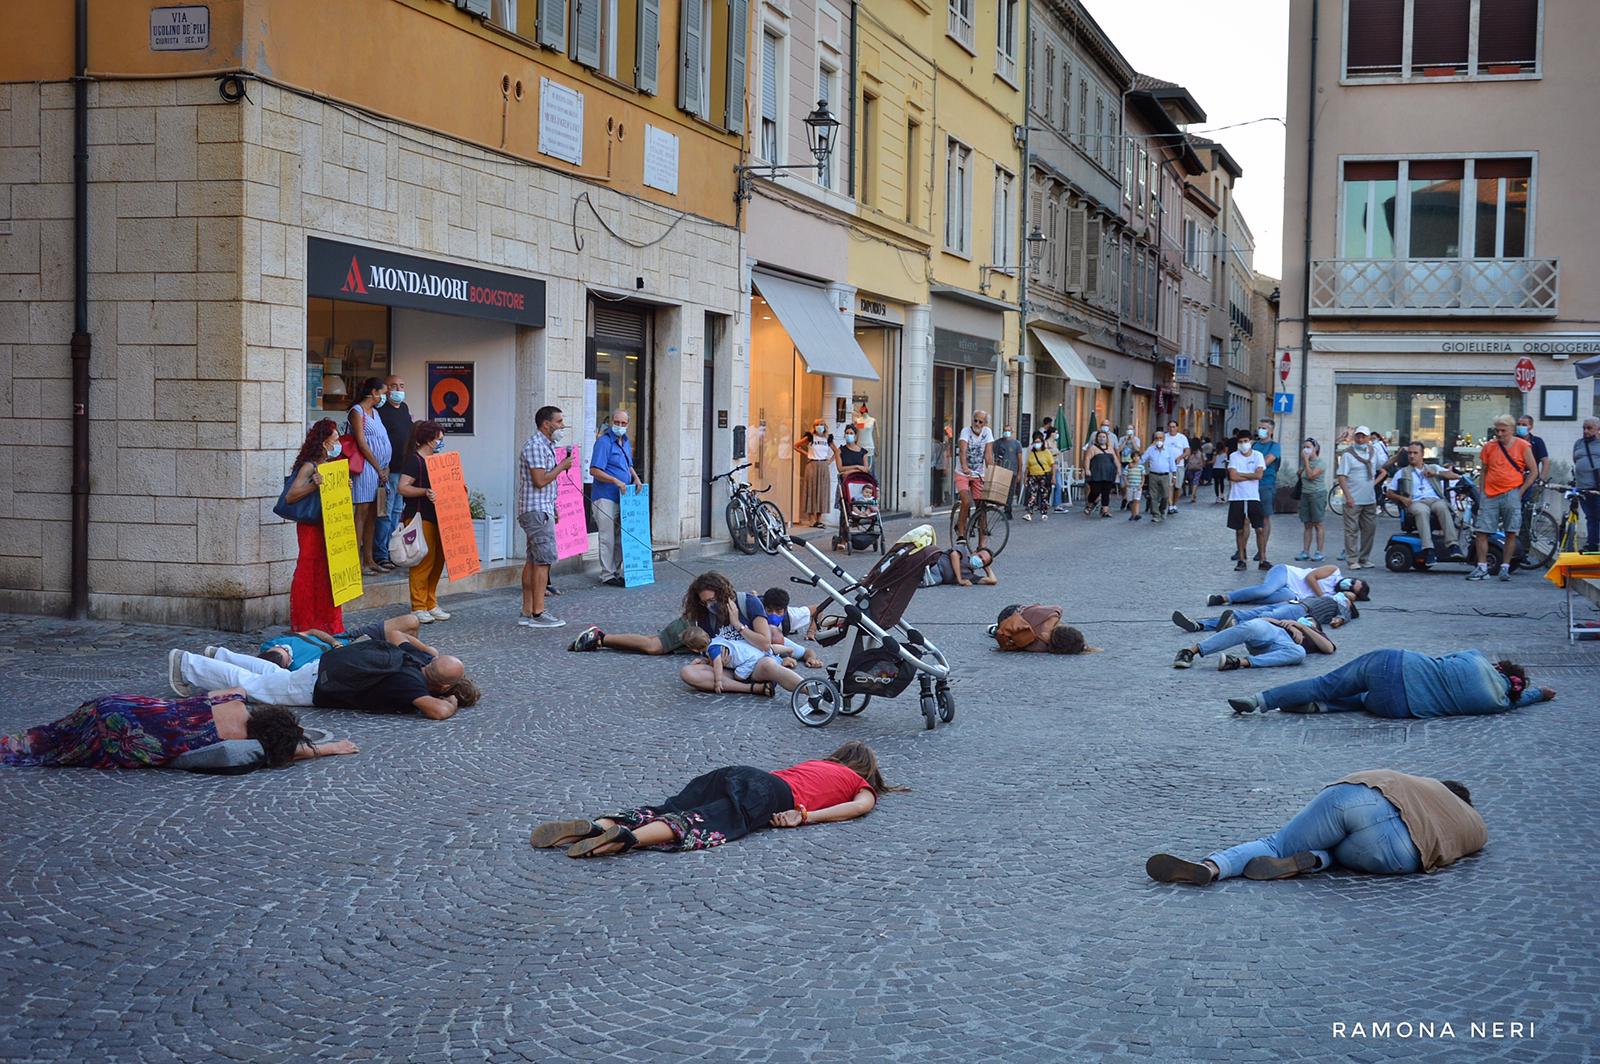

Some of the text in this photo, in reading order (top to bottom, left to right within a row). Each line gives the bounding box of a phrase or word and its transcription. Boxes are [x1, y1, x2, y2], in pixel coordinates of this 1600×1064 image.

[172, 12, 188, 23] VIA
[153, 24, 181, 36] UGOLINO
[368, 265, 525, 311] MONDADORI BOOKSTORE
[1442, 342, 1600, 353] GIOIELLERIA OROLOGERIA
[1515, 367, 1536, 382] STOP
